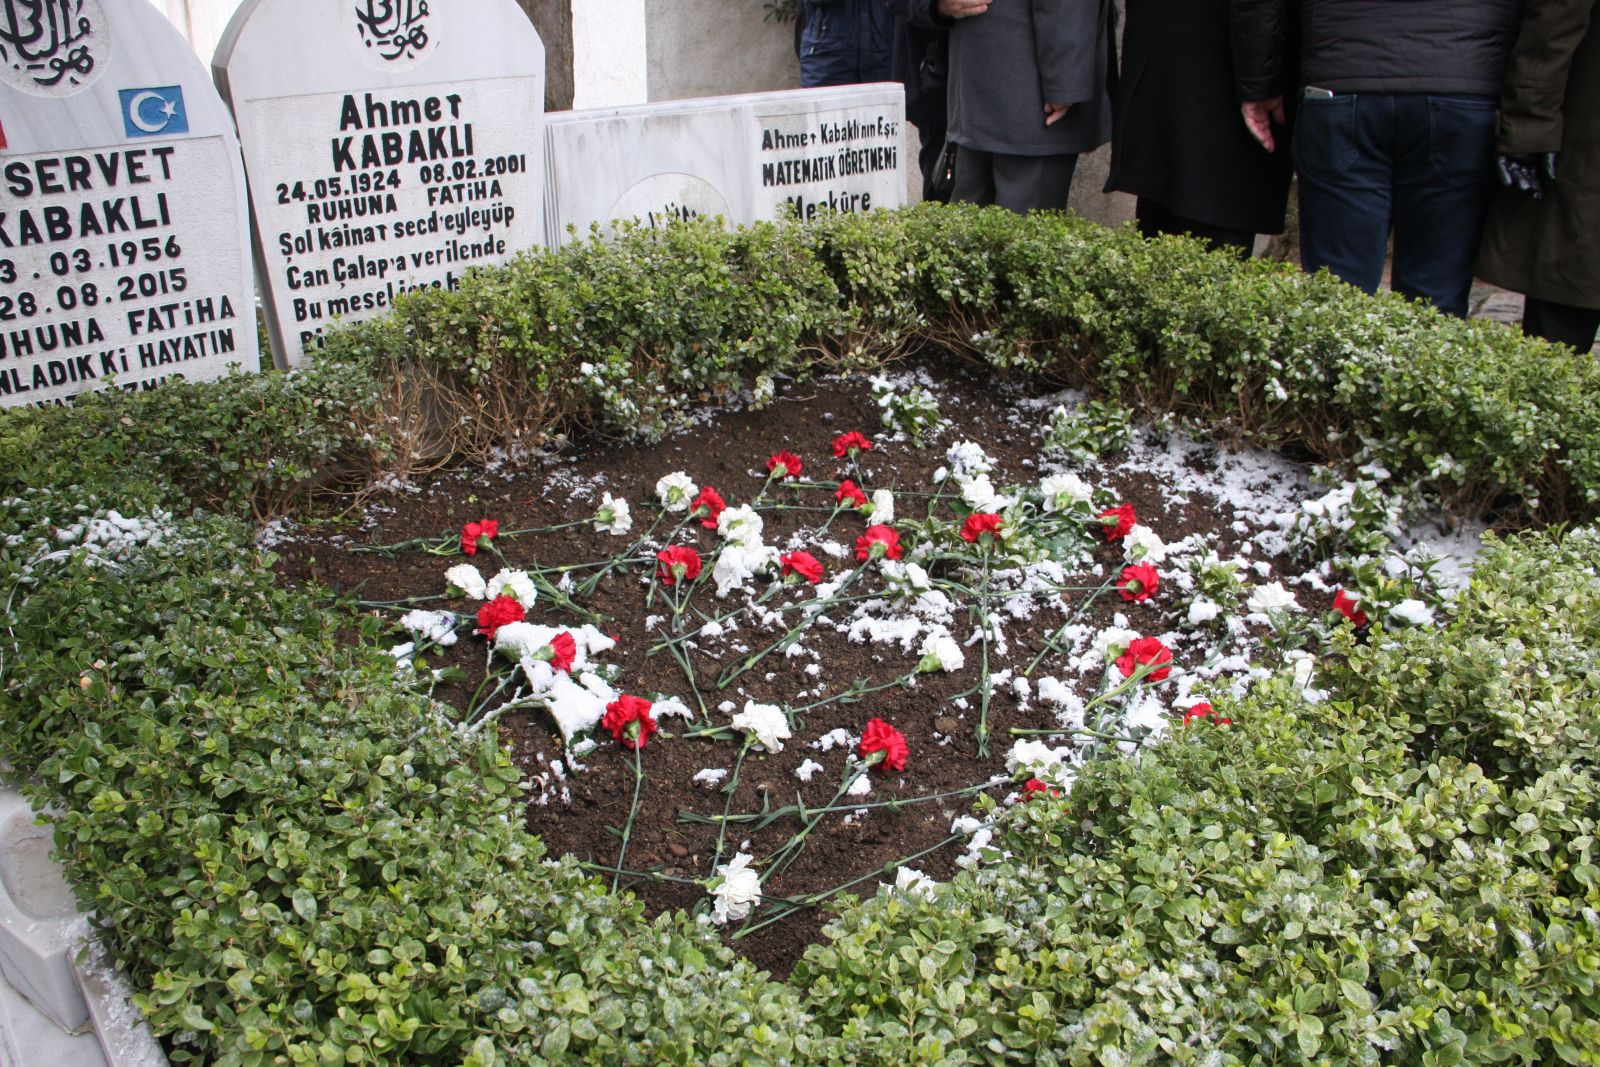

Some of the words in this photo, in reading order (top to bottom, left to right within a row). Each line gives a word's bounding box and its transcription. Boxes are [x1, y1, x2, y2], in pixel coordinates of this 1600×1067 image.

[340, 93, 462, 131] Ahmet
[331, 123, 474, 173] KABAKLI
[762, 129, 816, 150] Ahmet
[4, 146, 175, 198] SERVET
[276, 169, 402, 204] 24.05.1924
[420, 154, 526, 184] 08.02.2001
[307, 193, 398, 224] RUHUNA
[279, 228, 314, 264] Şol
[317, 223, 388, 251] kâinat
[286, 265, 329, 290] Can
[332, 254, 406, 290] Çalap'a
[411, 233, 506, 268] verilende
[0, 267, 188, 321] 28.08.2015
[293, 297, 321, 322] Bu
[327, 281, 394, 316] mesel
[0, 317, 105, 360] HUNA
[138, 328, 236, 369] HAYATIN
